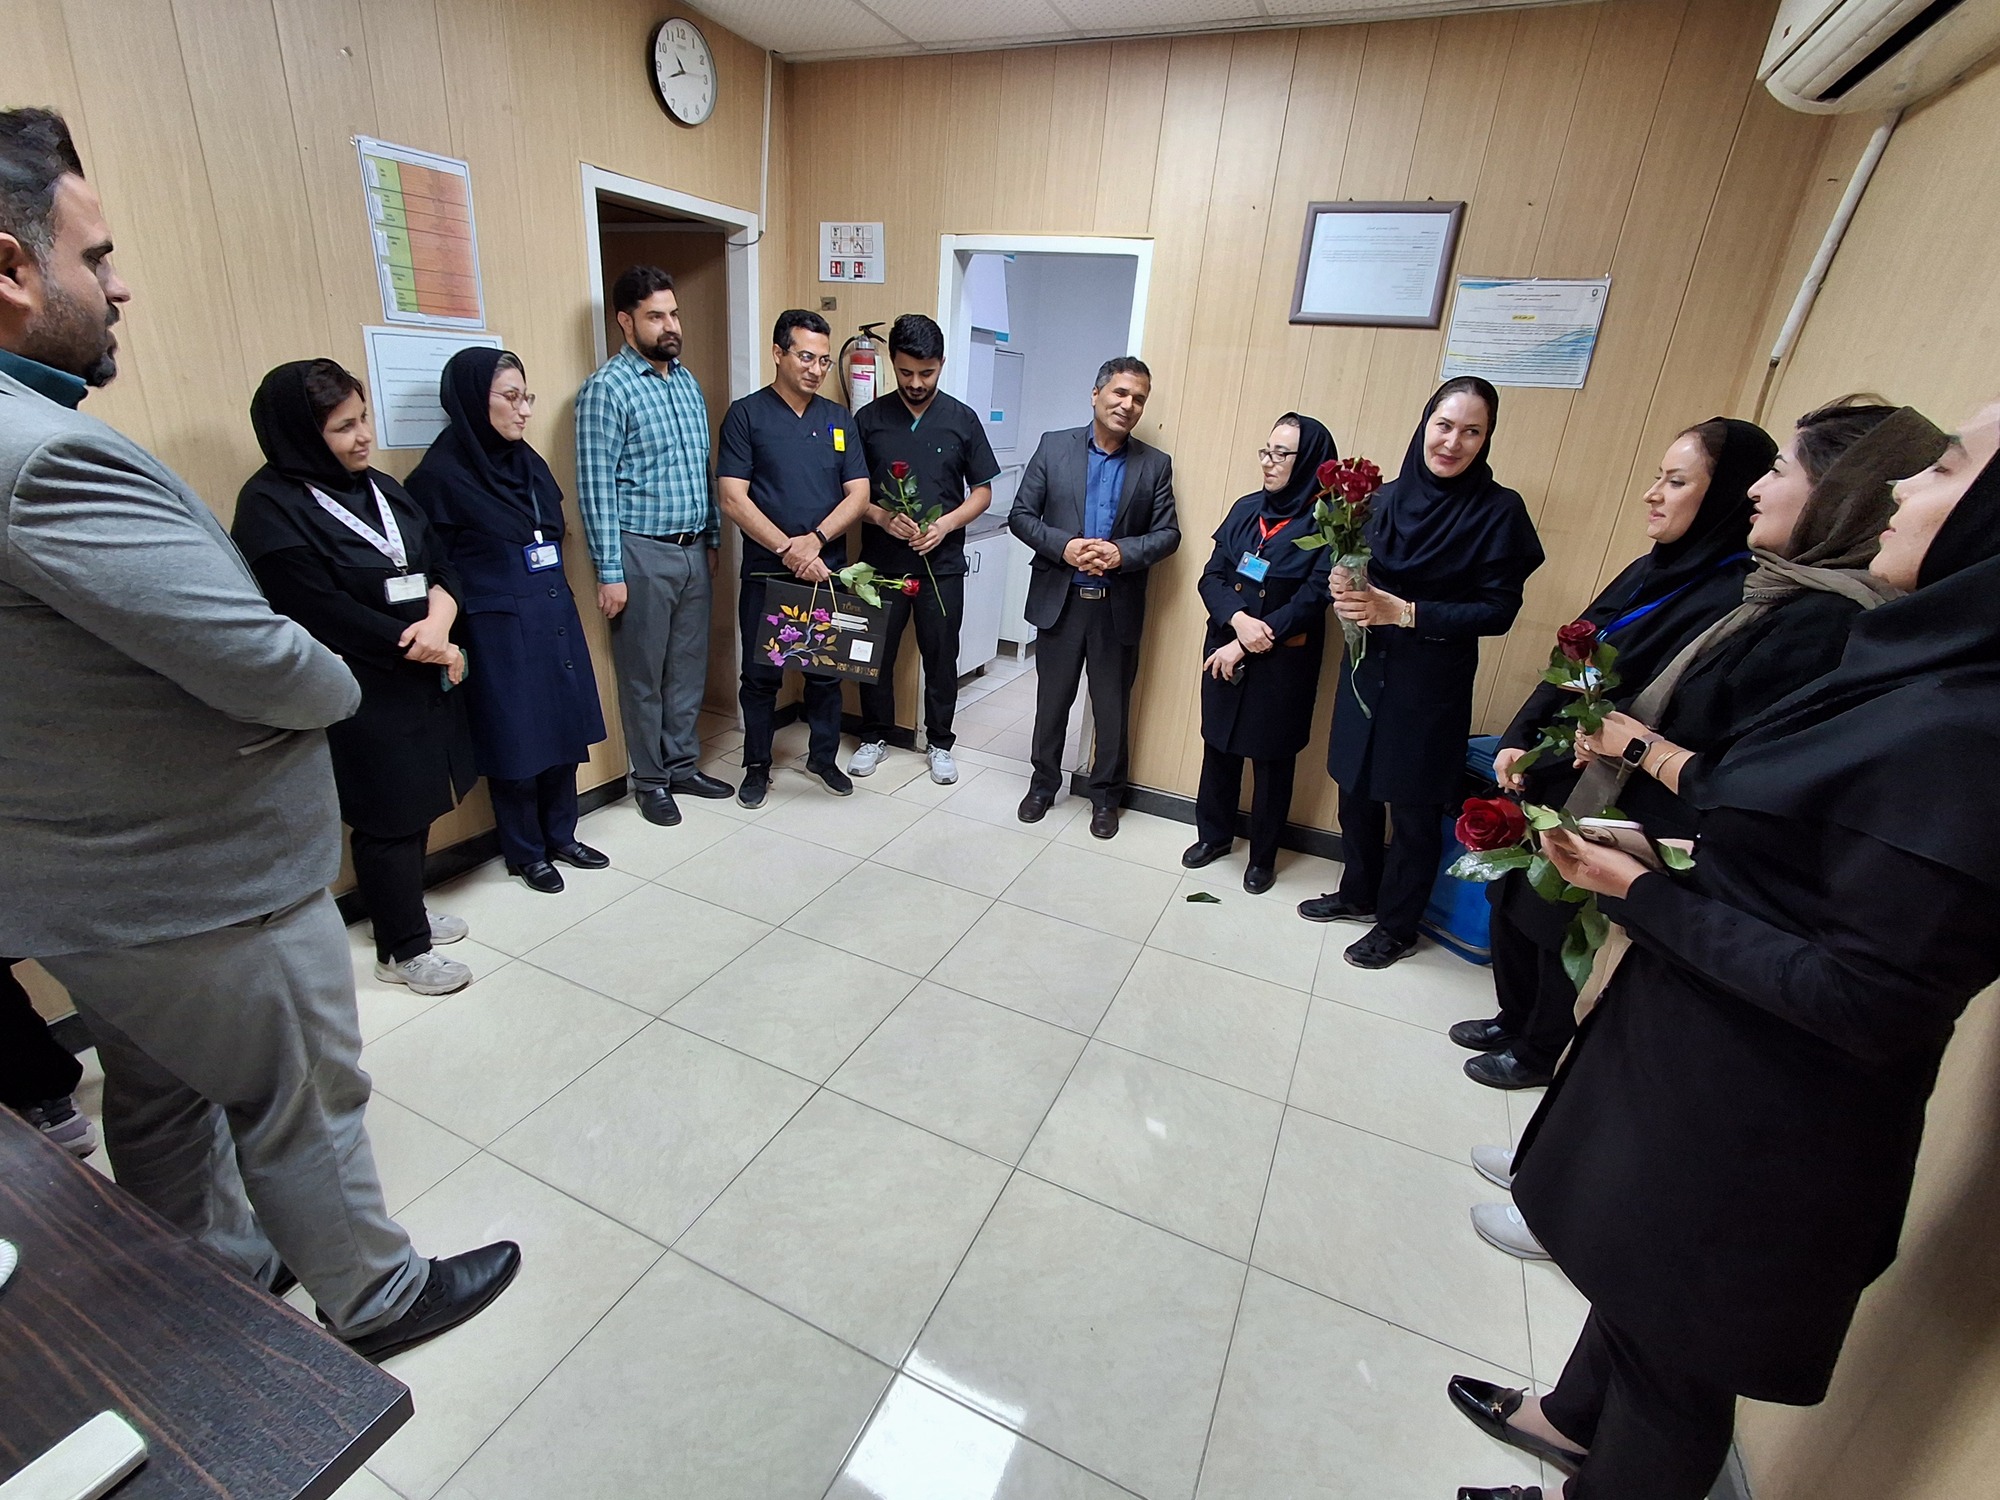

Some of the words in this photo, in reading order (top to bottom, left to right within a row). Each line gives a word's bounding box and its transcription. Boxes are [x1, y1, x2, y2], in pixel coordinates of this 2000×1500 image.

[666, 29, 674, 42] 11
[676, 26, 686, 40] 12
[658, 41, 667, 54] 10
[692, 38, 696, 49] 1
[656, 60, 662, 72] 9
[699, 54, 705, 66] 2
[703, 74, 708, 86] 3
[660, 81, 666, 92] 8
[670, 98, 676, 109] 7
[702, 93, 706, 104] 4
[683, 107, 688, 120] 6
[694, 104, 700, 116] 5
